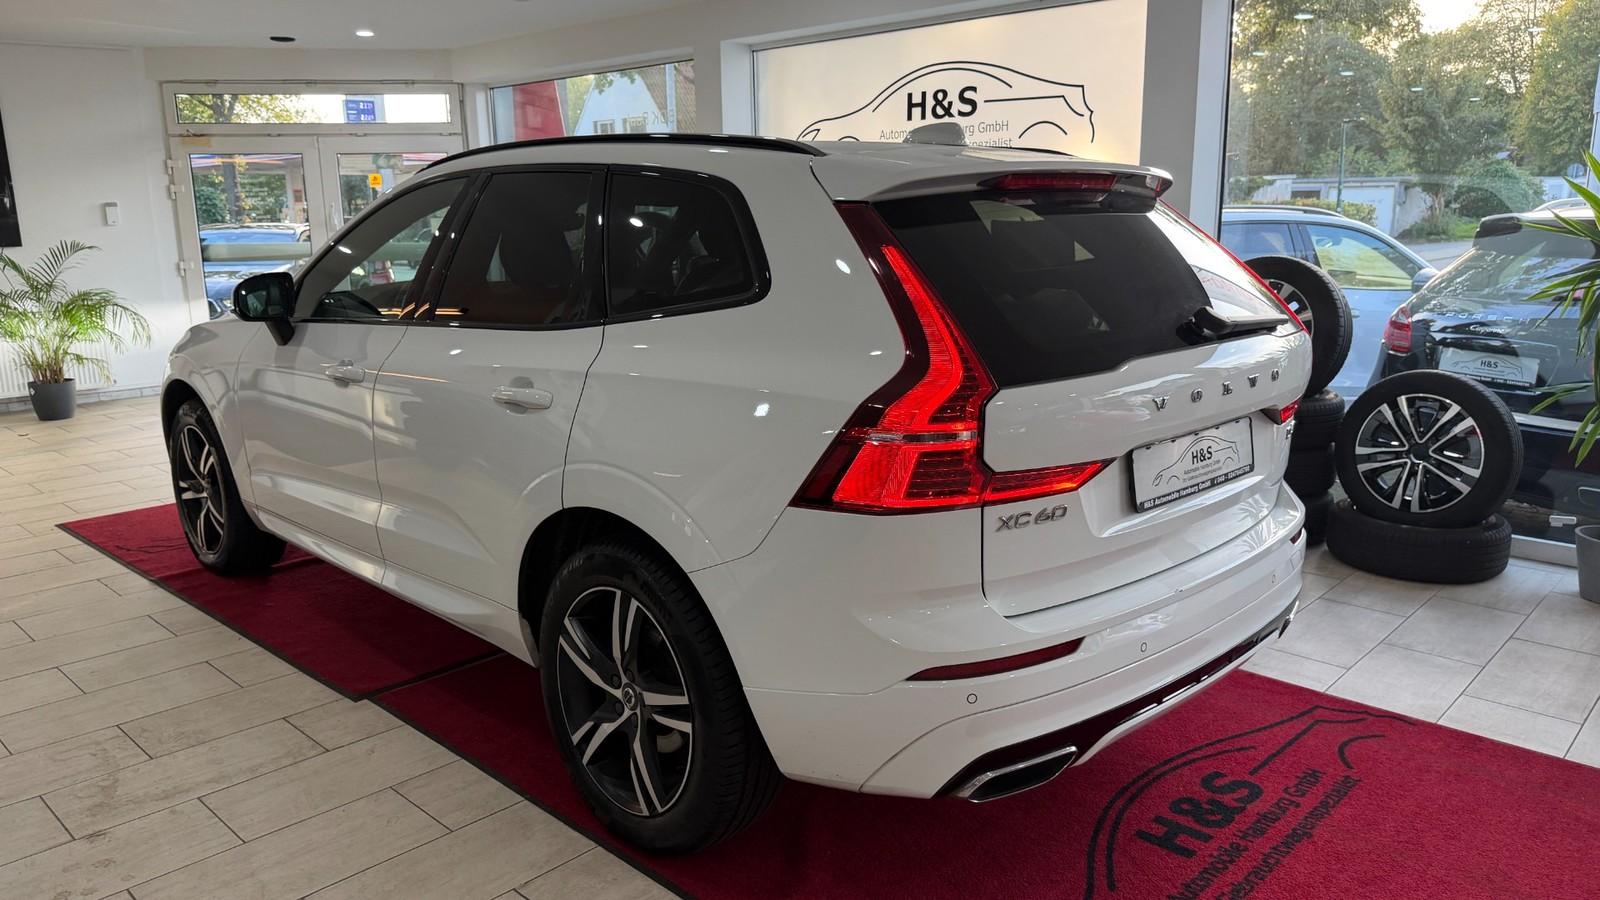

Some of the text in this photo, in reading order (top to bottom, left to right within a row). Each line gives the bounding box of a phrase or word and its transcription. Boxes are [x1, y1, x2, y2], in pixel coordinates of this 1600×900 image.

[906, 86, 978, 122] H&S
[977, 120, 1009, 134] GmbH
[1480, 359, 1499, 369] H&S
[1152, 368, 1280, 412] VOLVO
[1191, 445, 1213, 465] H&S
[1143, 498, 1154, 509] H&S
[1135, 770, 1264, 859] H&S
